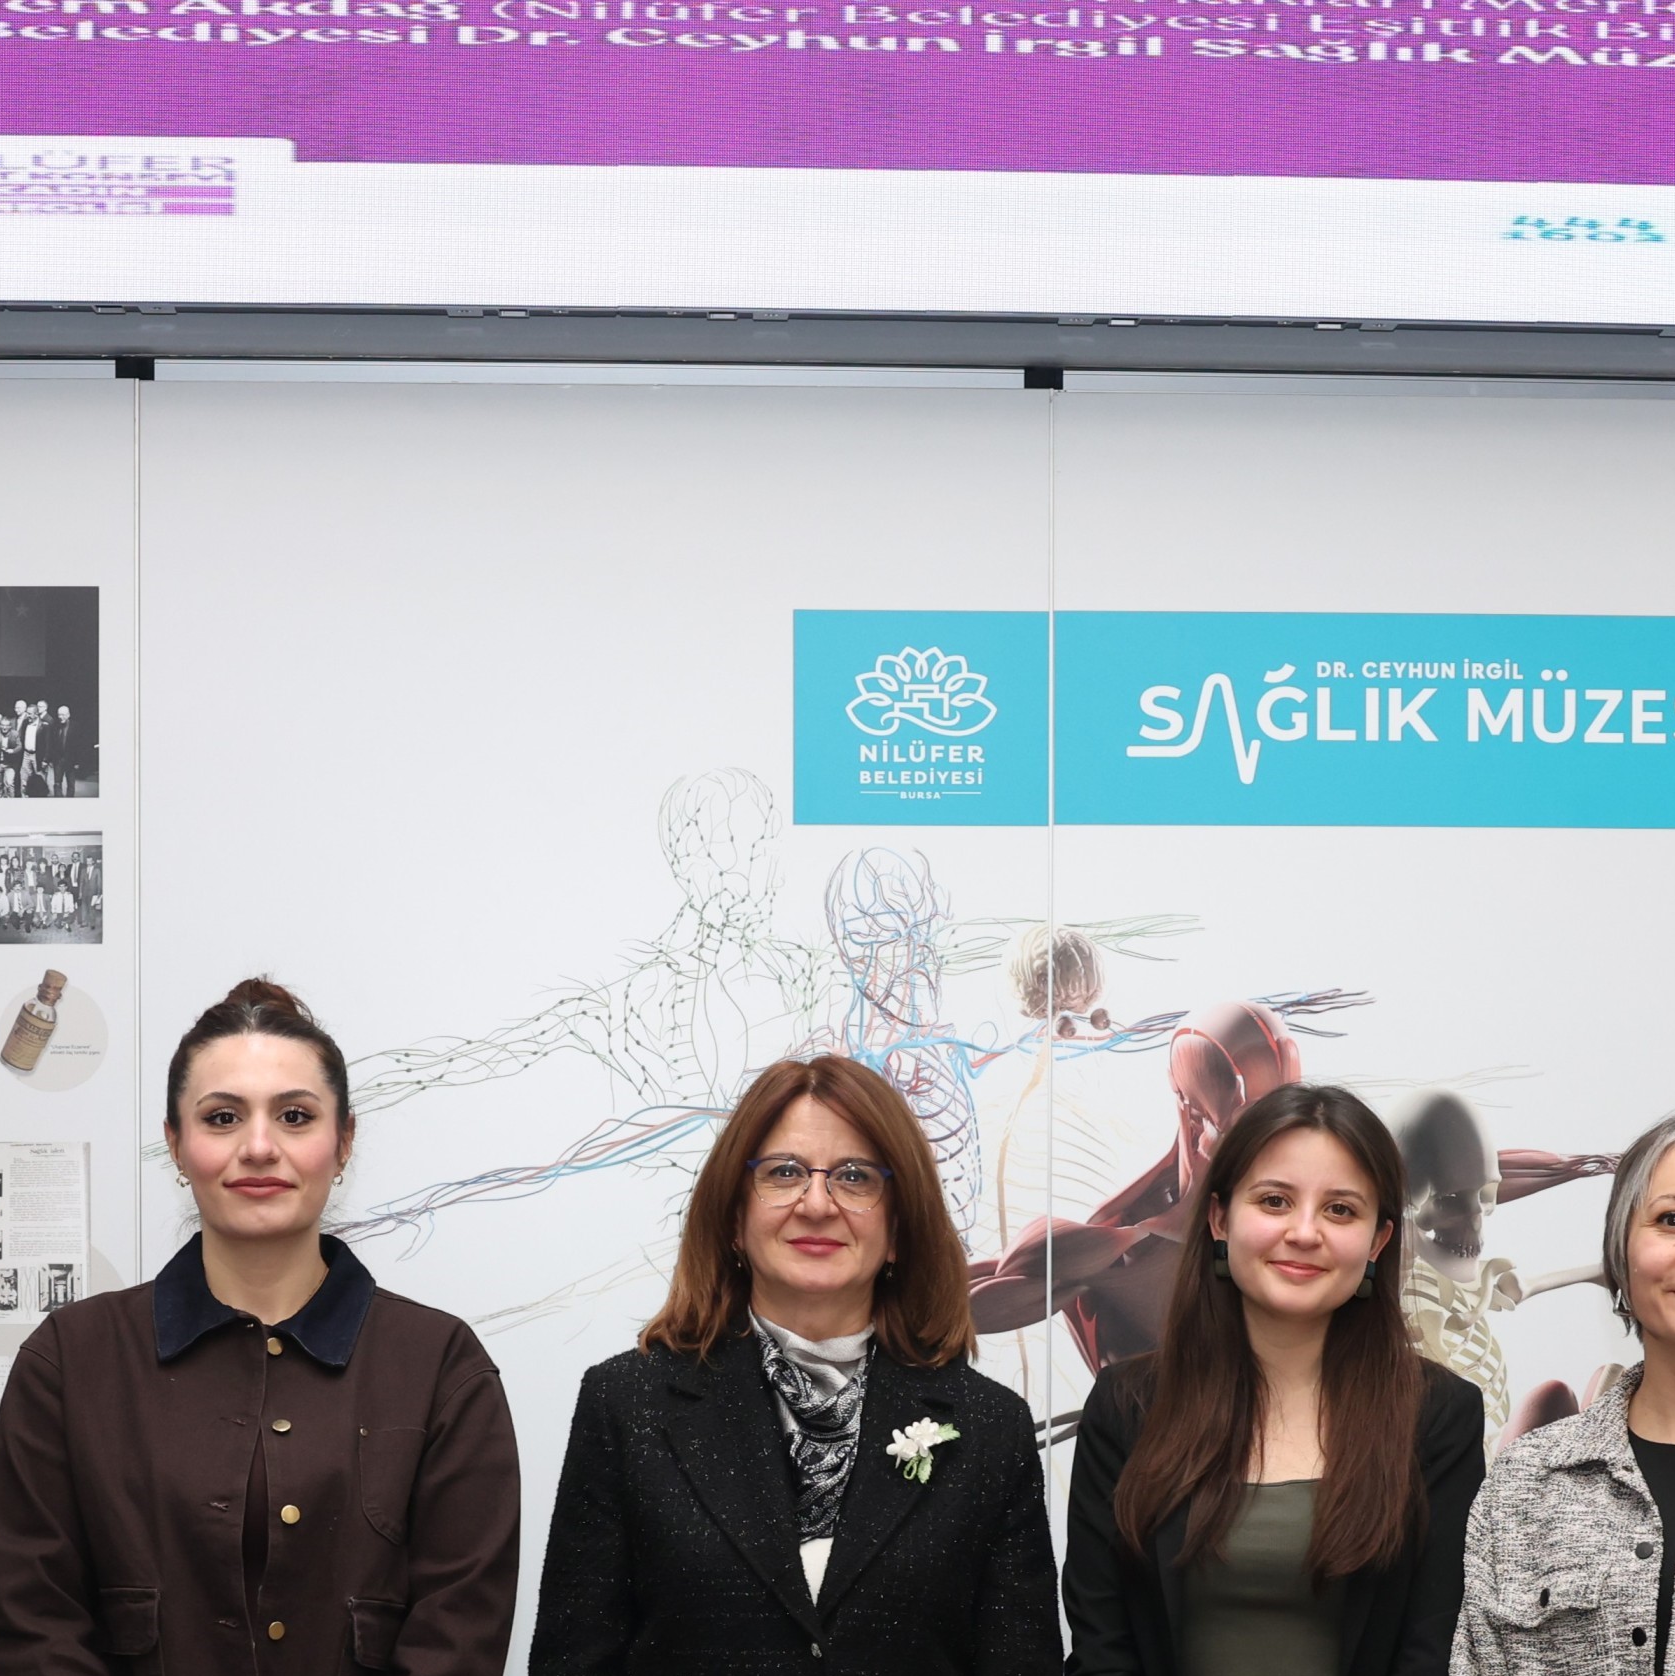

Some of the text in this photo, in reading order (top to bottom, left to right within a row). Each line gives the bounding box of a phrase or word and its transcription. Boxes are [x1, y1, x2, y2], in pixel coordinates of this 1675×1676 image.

[843, 5, 1280, 31] Belediyesi
[455, 26, 581, 46] Dr.
[605, 28, 962, 52] Ceyhun
[1191, 38, 1478, 64] Sağlık
[1316, 656, 1524, 681] DR. CEYHUN İRGİL
[1126, 661, 1440, 785] SAĞLIK
[860, 733, 985, 763] NİLÜFER
[859, 766, 983, 786] BELEDİYESİ
[900, 791, 941, 800] BURSA
